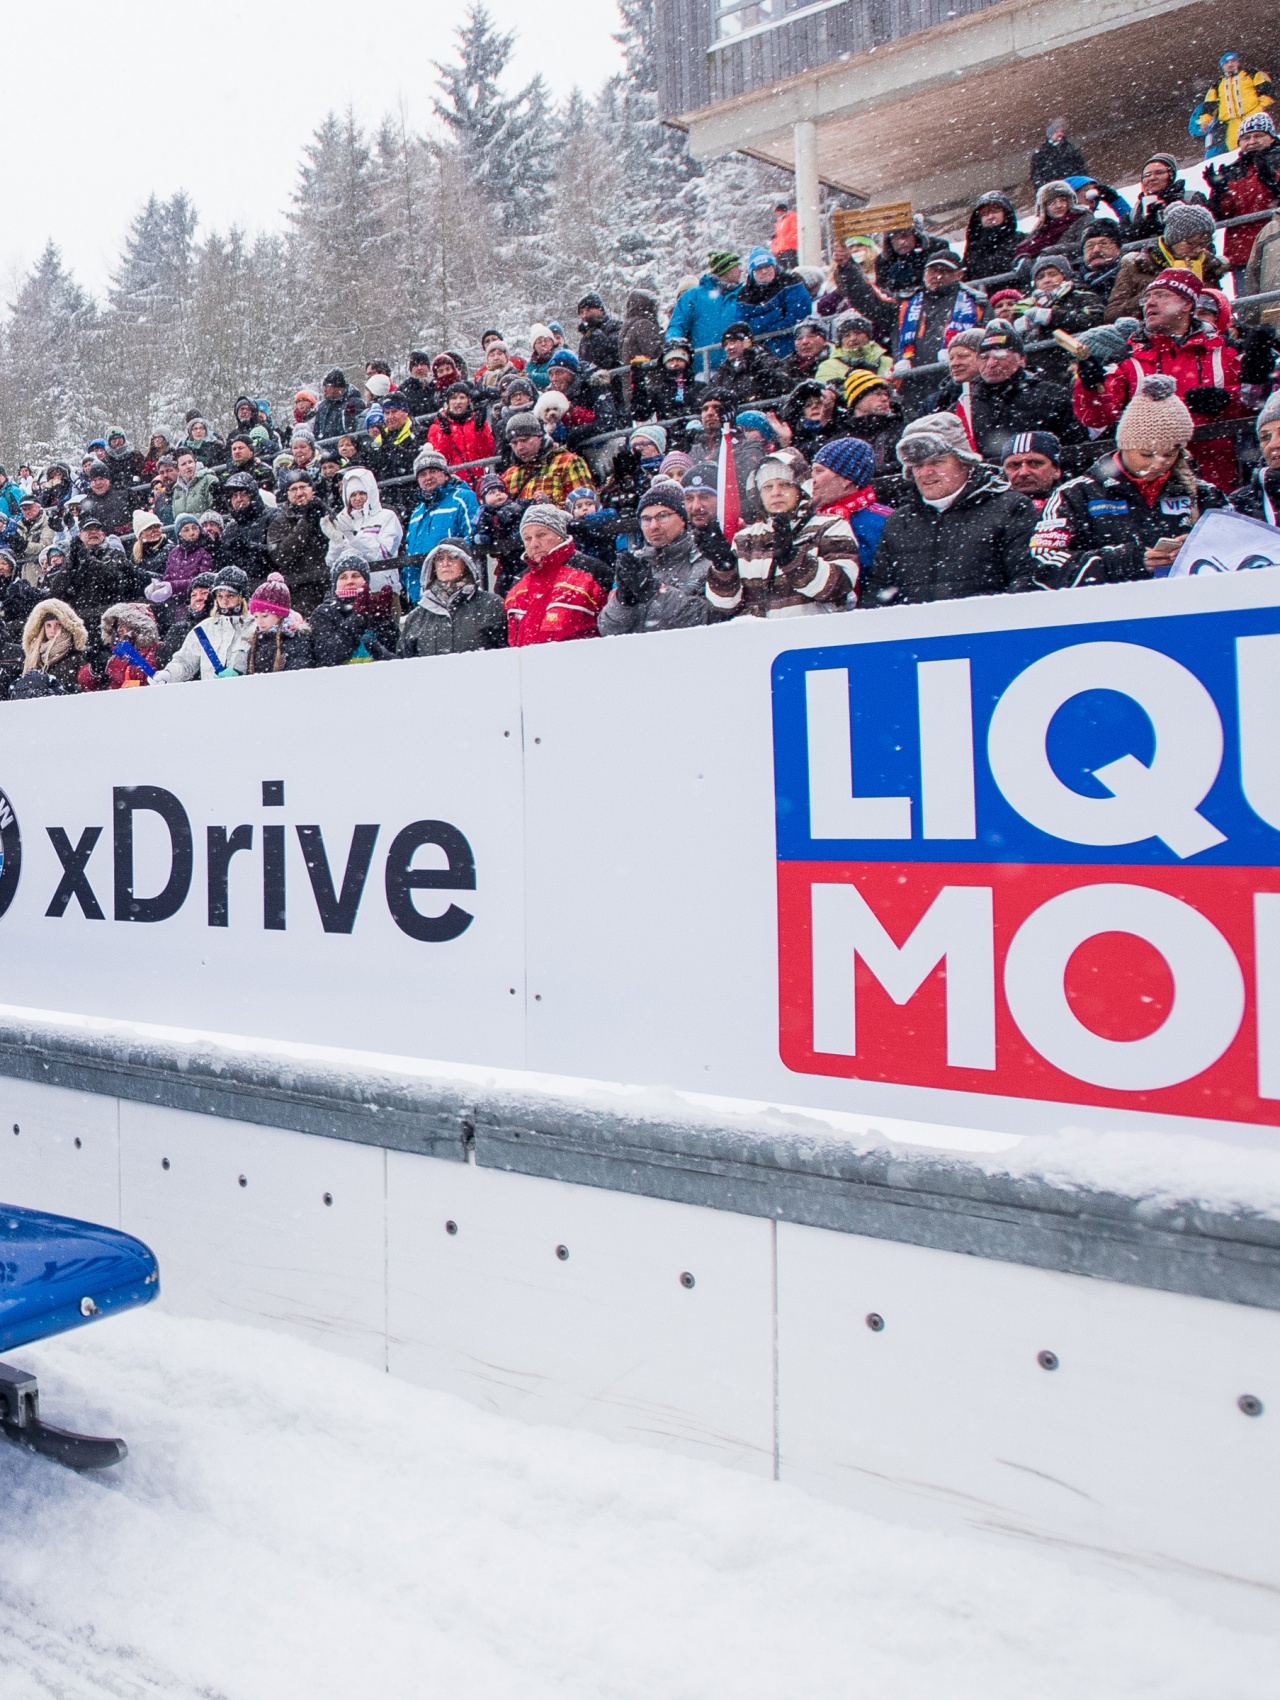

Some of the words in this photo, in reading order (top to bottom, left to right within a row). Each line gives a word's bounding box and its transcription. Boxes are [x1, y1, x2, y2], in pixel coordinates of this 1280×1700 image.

[1164, 499, 1190, 510] VIS
[804, 634, 1280, 860] LIQ
[44, 780, 477, 944] xDrive
[810, 882, 1280, 1102] MO
